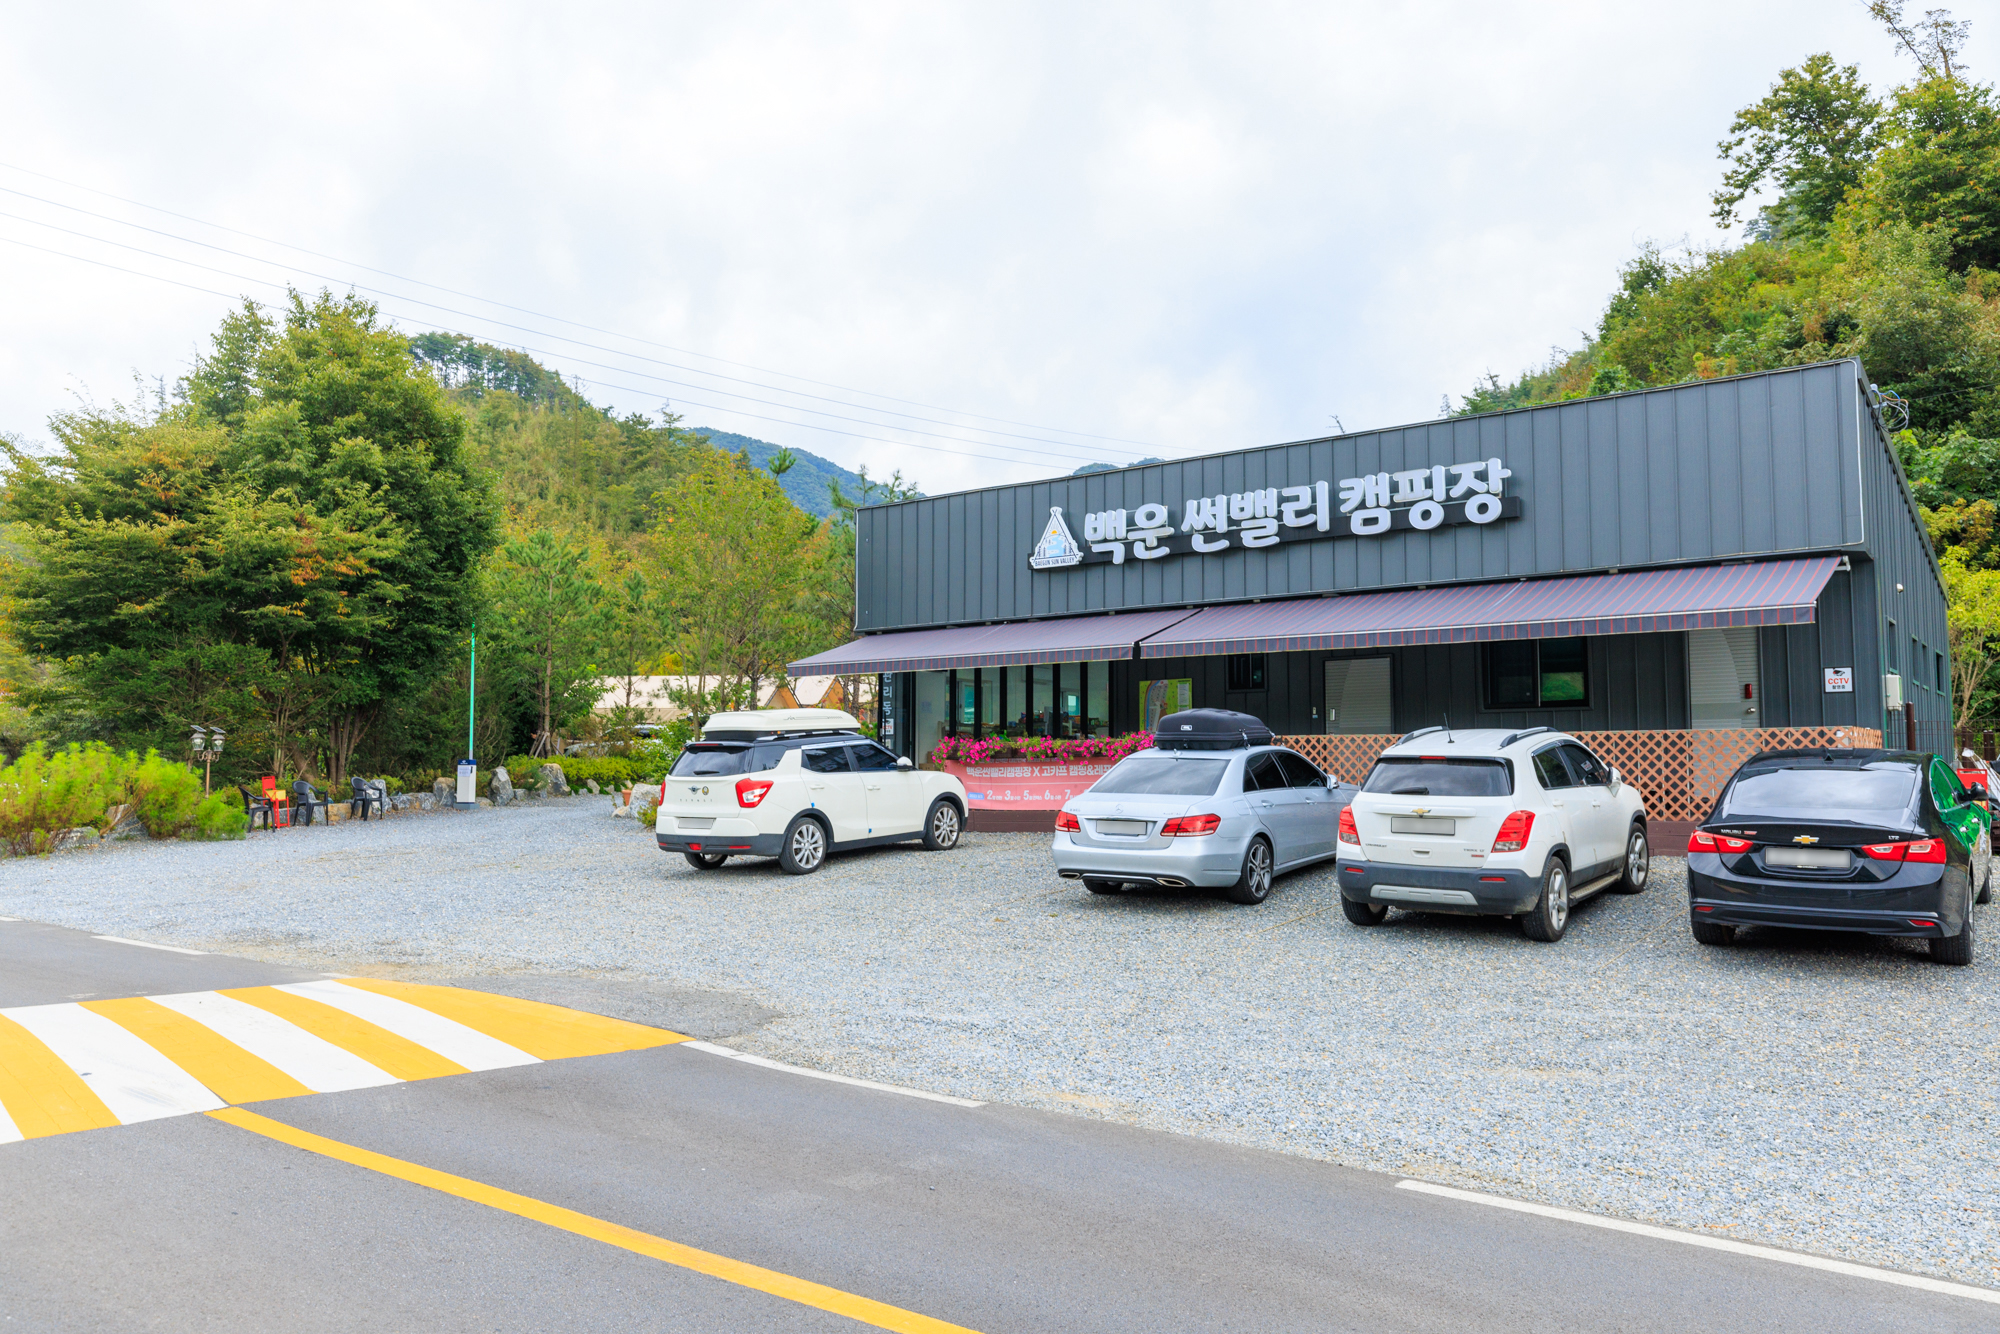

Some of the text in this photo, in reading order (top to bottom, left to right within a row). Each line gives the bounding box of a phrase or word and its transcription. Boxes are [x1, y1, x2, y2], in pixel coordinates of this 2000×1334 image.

[1085, 457, 1512, 565] 백운 썬밸리 캠핑장
[966, 766, 1032, 777] 백운썬밸리캠핑장
[1041, 765, 1068, 777] 고카프
